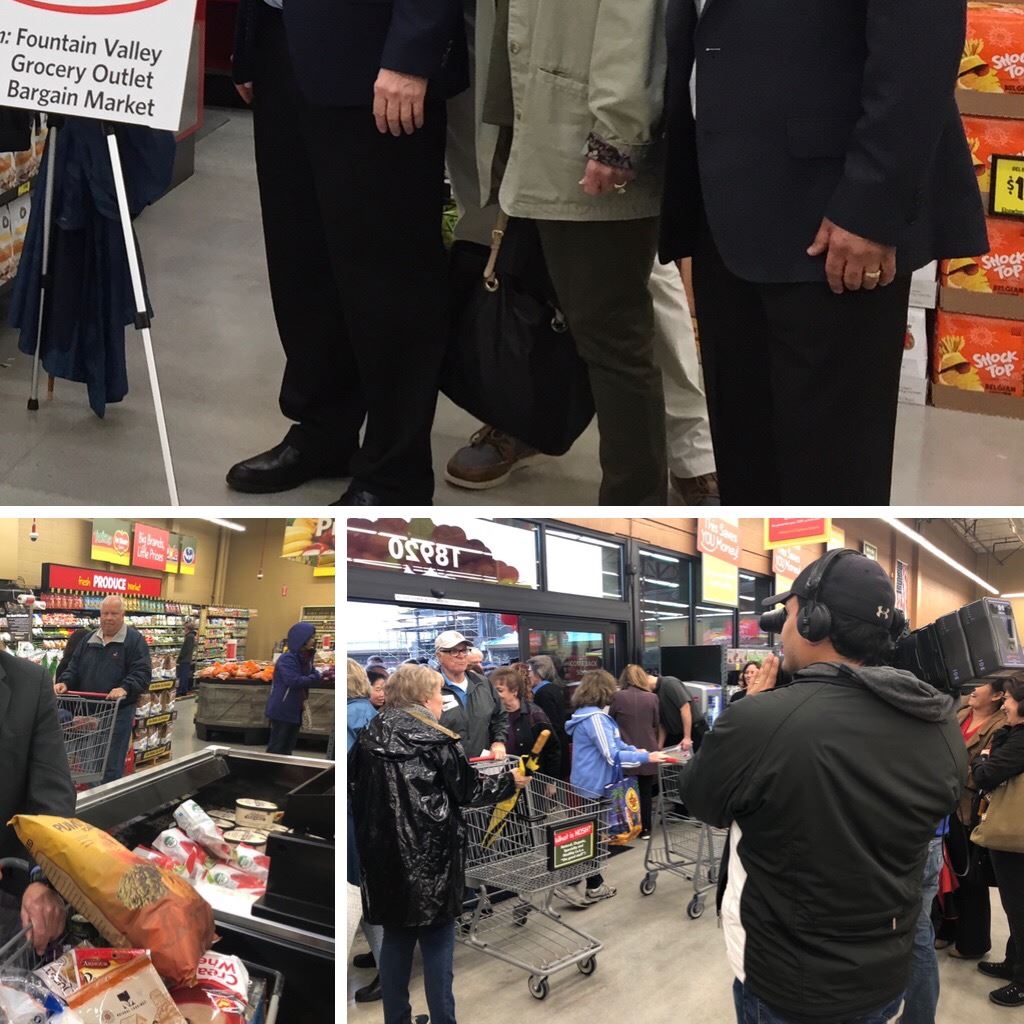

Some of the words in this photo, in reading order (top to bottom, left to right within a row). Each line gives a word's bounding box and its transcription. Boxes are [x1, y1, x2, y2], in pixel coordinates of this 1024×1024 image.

[16, 27, 98, 55] Fountain
[104, 37, 163, 67] Valley
[10, 53, 87, 84] Grocery
[92, 63, 155, 90] Outlet
[6, 79, 79, 107] Bargain
[83, 89, 156, 118] Market
[1007, 176, 1024, 201] $1
[972, 350, 1019, 369] SHOCK
[987, 362, 1015, 378] TOP
[984, 383, 1016, 393] BELGIAN
[138, 531, 147, 547] Big
[137, 548, 149, 560] Little
[149, 549, 164, 562] Prices
[78, 576, 91, 587] fresh
[92, 574, 127, 591] PRODUCE
[127, 582, 142, 592] market
[197, 967, 239, 986] Crea
